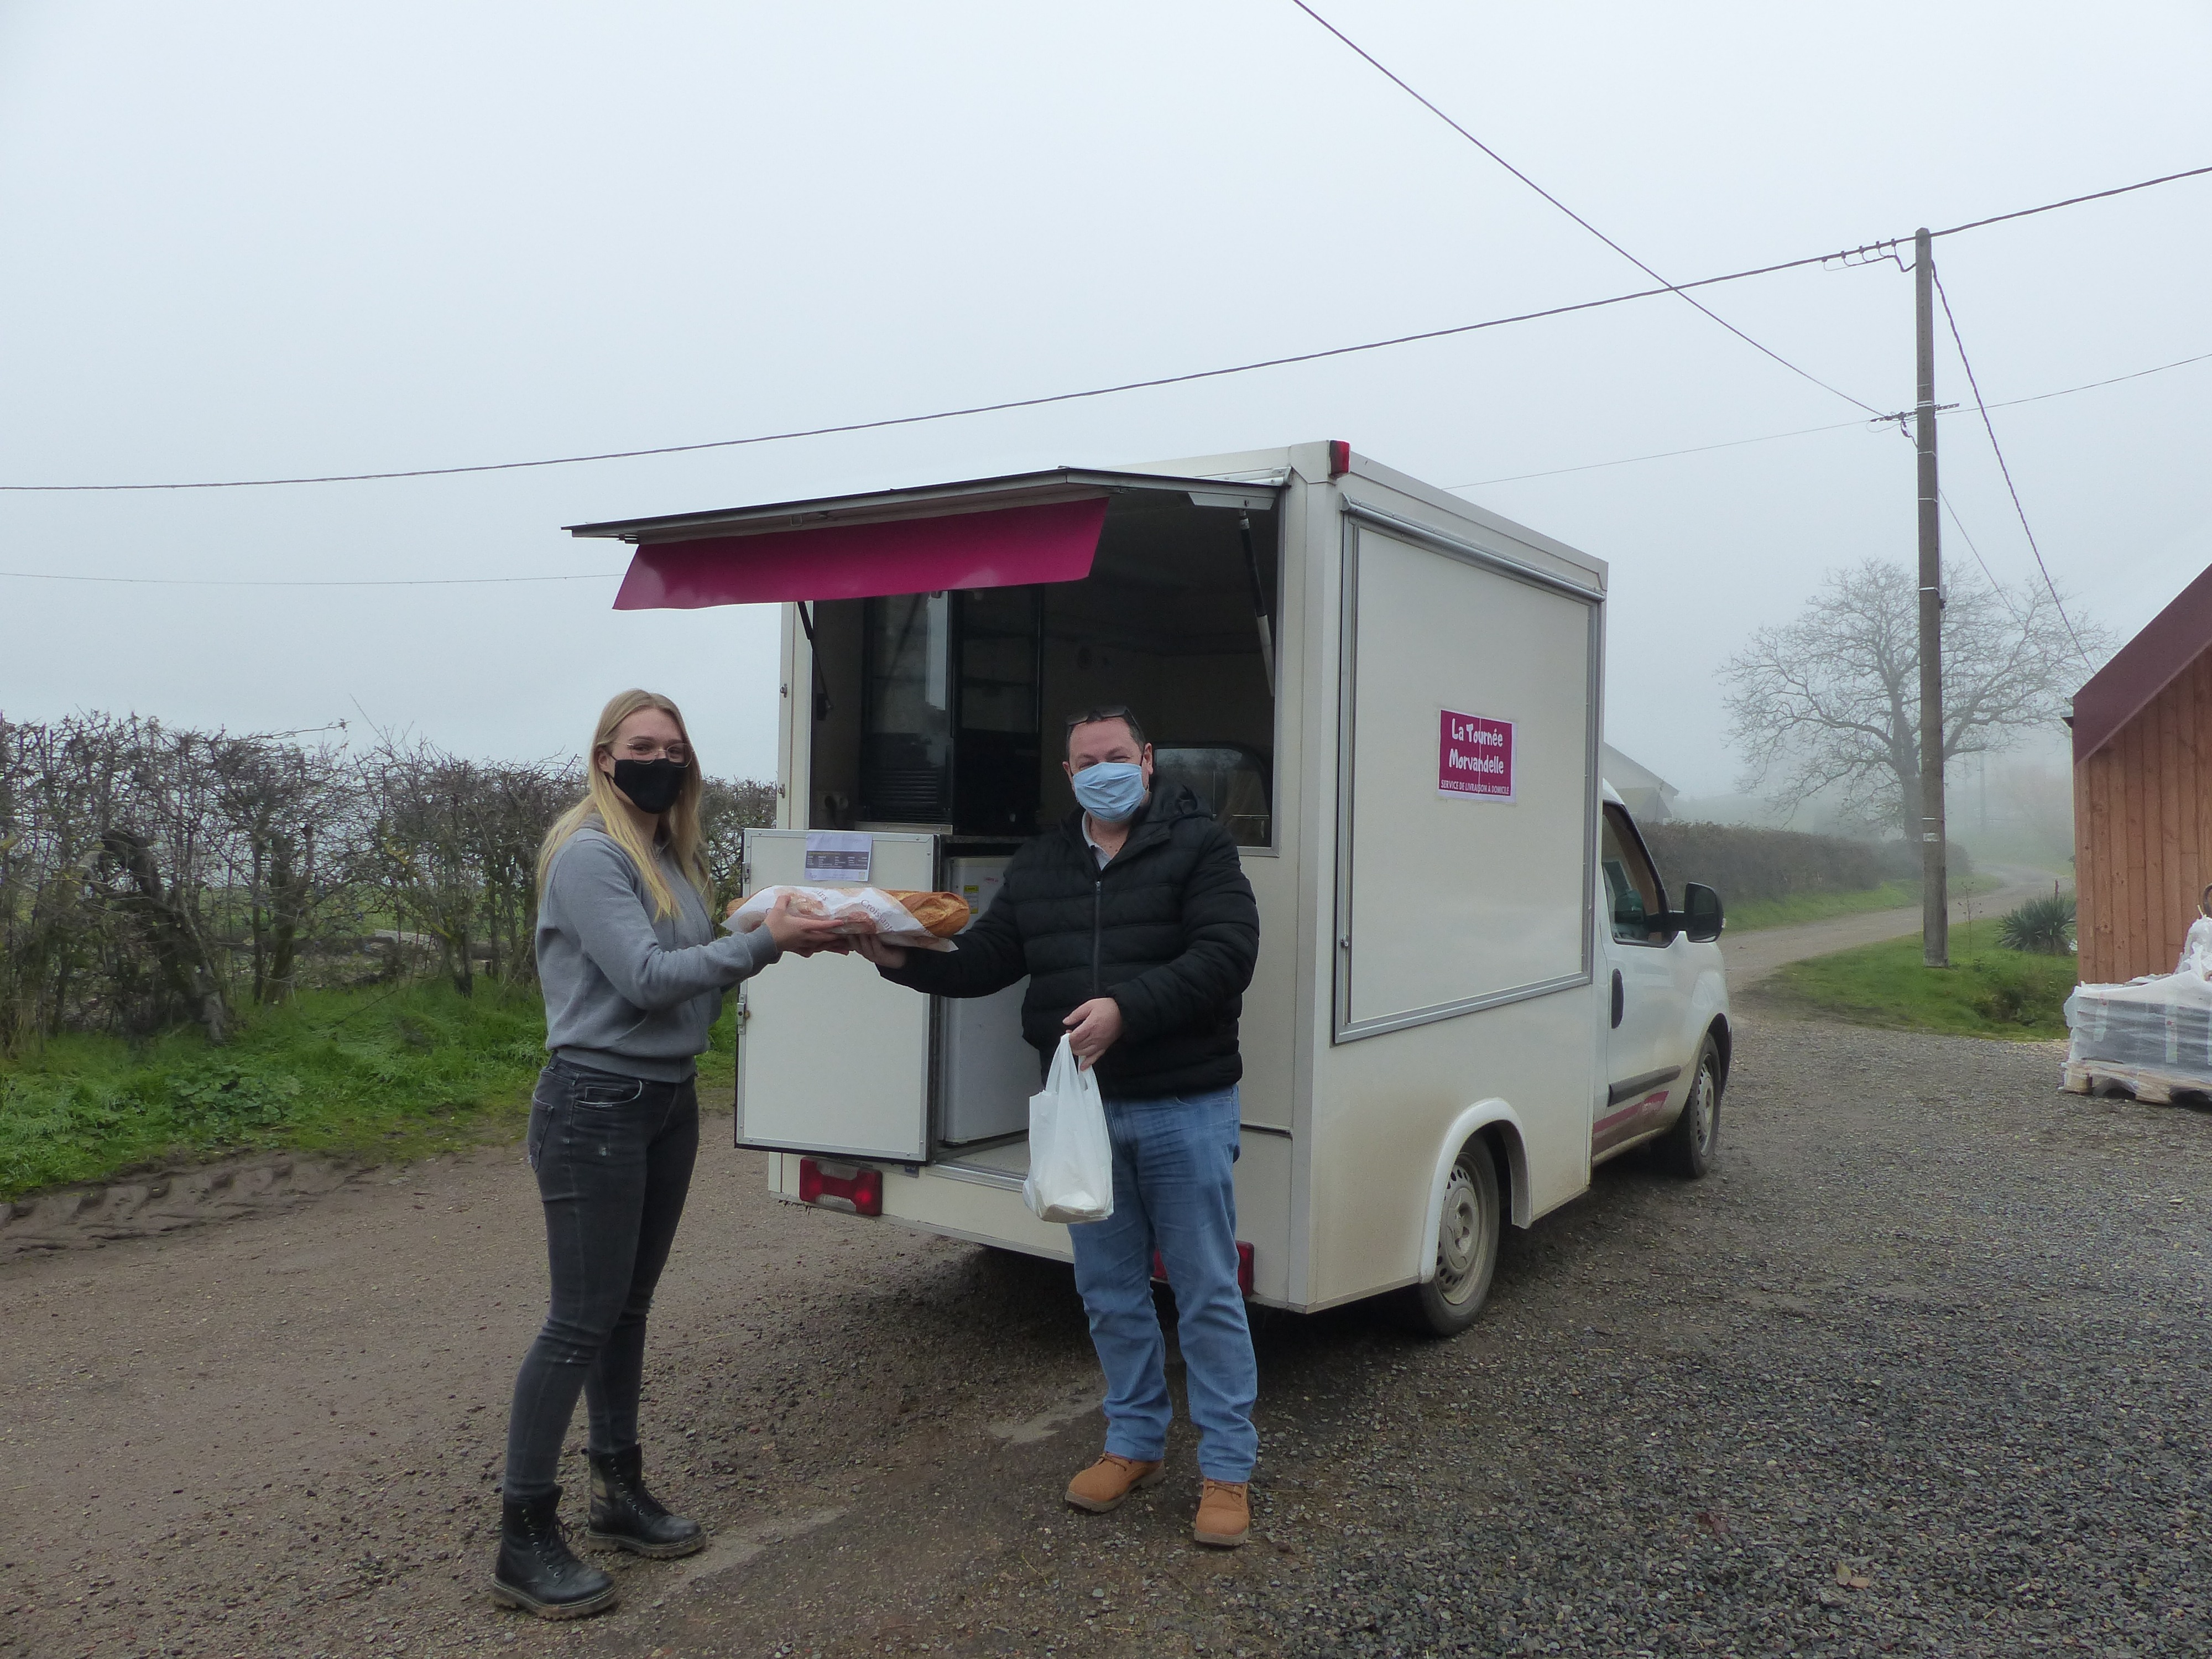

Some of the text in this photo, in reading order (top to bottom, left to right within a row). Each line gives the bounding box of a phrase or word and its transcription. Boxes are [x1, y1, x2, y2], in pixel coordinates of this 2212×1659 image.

[1452, 718, 1503, 747] La Tournée
[1449, 748, 1504, 774] Morvandelle
[1441, 779, 1459, 790] SERVICE
[1459, 781, 1465, 791] DE
[1465, 782, 1488, 792] LIVRAISON
[1491, 785, 1510, 794] DOMICILE
